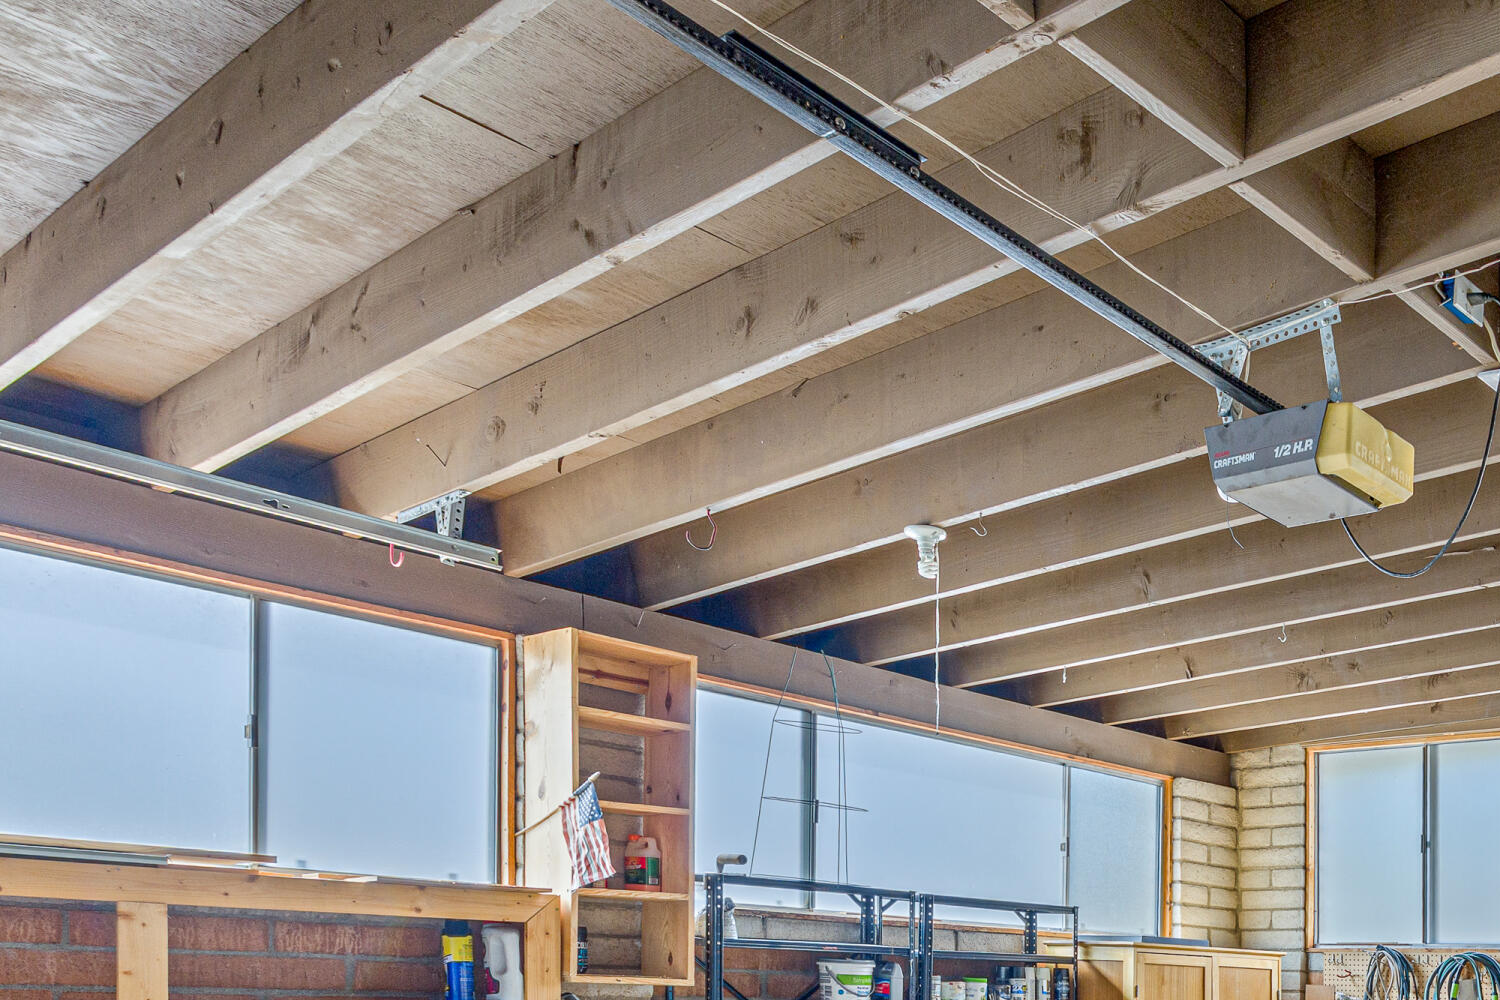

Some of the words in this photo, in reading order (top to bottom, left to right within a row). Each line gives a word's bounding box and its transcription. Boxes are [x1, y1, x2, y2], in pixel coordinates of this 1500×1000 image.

[1274, 443, 1291, 458] 1/2
[1213, 451, 1256, 469] CRAFTSMAN
[1355, 440, 1411, 487] CRAFTMAN
